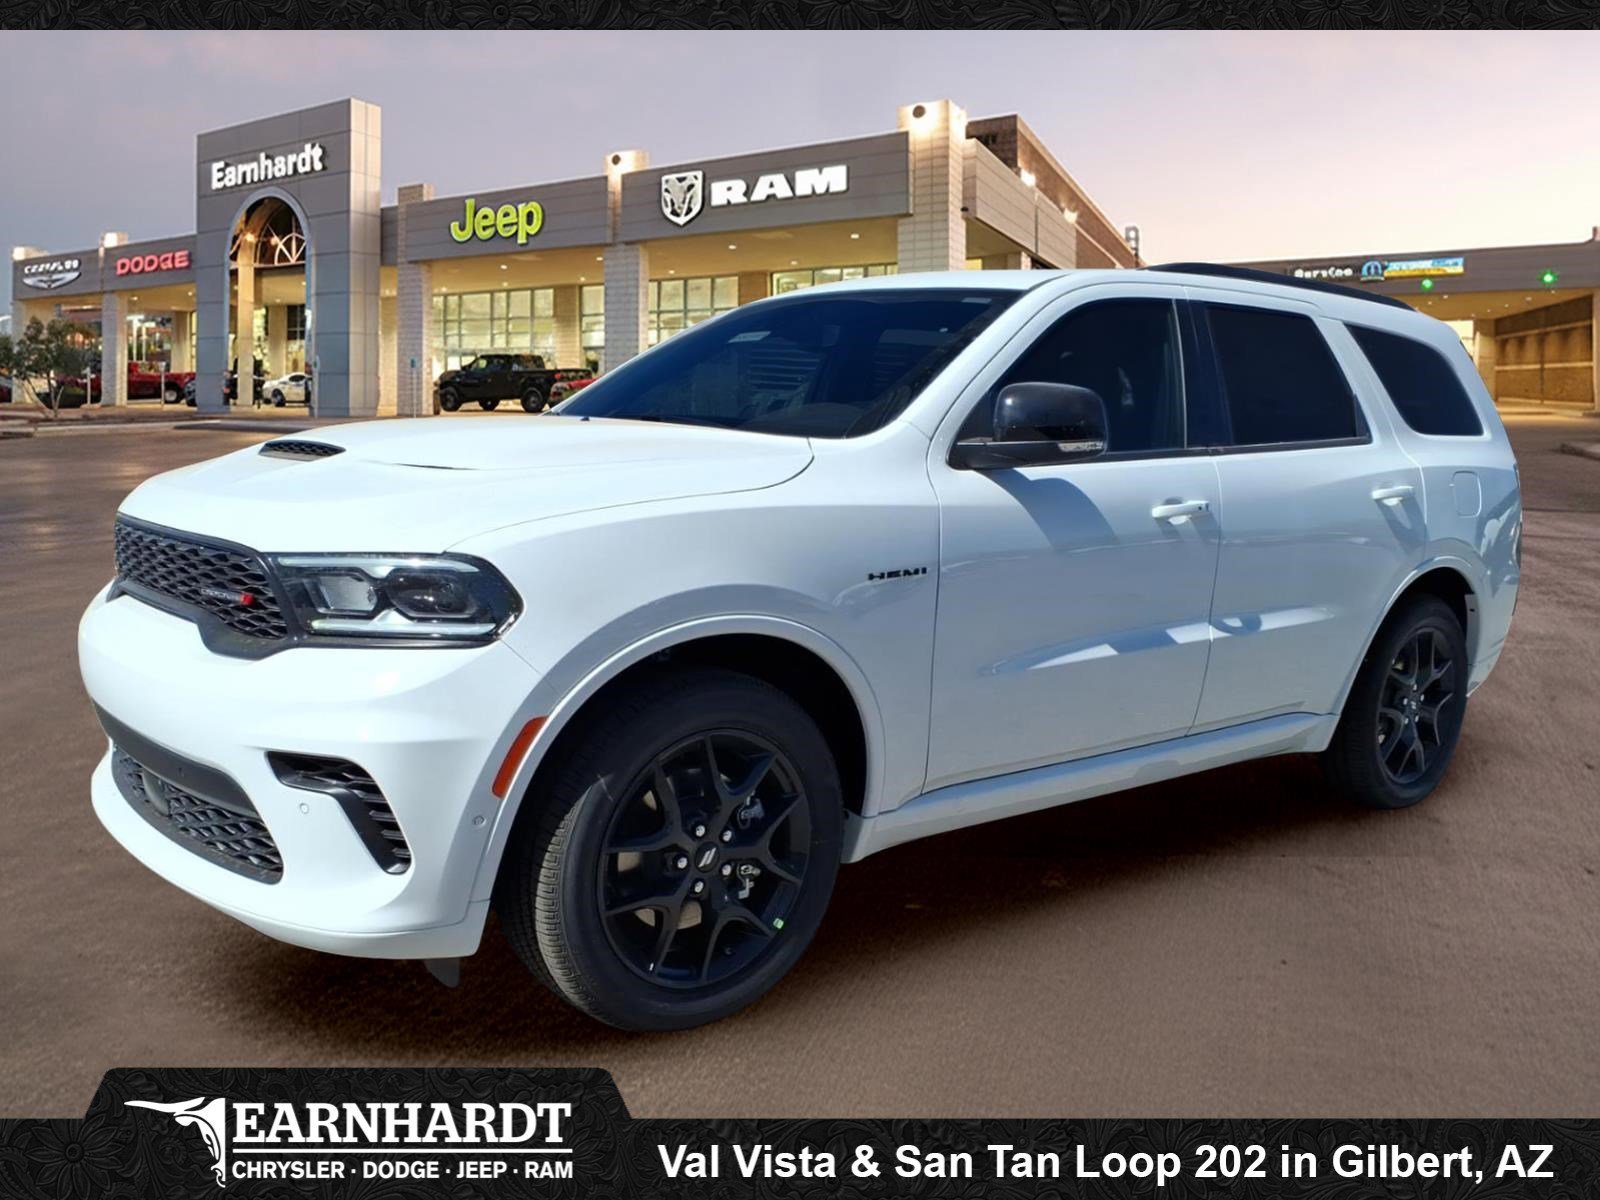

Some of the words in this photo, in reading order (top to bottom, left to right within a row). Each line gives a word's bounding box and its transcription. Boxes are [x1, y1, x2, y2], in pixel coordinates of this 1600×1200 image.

[210, 142, 325, 190] Earnhardt
[710, 164, 848, 207] RAM
[449, 198, 545, 245] Jeep
[115, 250, 191, 277] DODGE
[867, 567, 928, 581] HEMI
